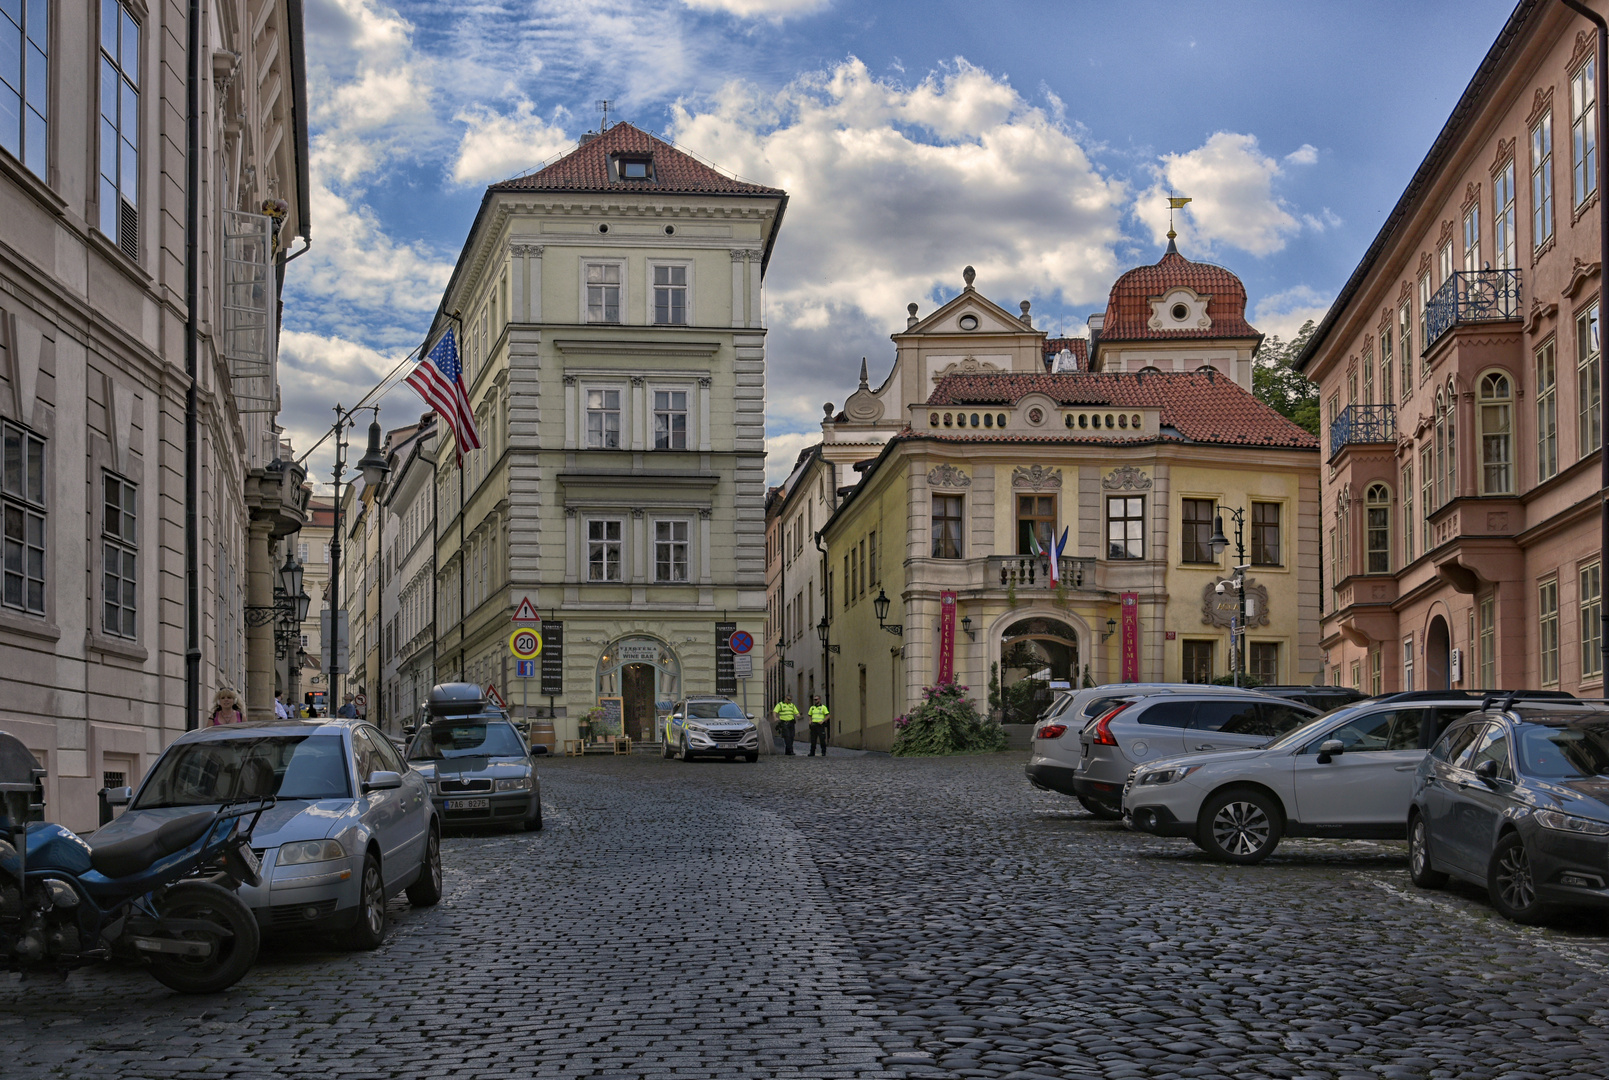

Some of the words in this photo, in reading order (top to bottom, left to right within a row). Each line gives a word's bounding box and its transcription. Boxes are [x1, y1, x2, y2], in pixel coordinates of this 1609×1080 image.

[518, 637, 533, 649] 20
[942, 614, 952, 678] ALCHYMIST
[1125, 615, 1135, 679] ALCHYMIST
[450, 800, 463, 808] 7A6
[468, 799, 486, 807] 8275
